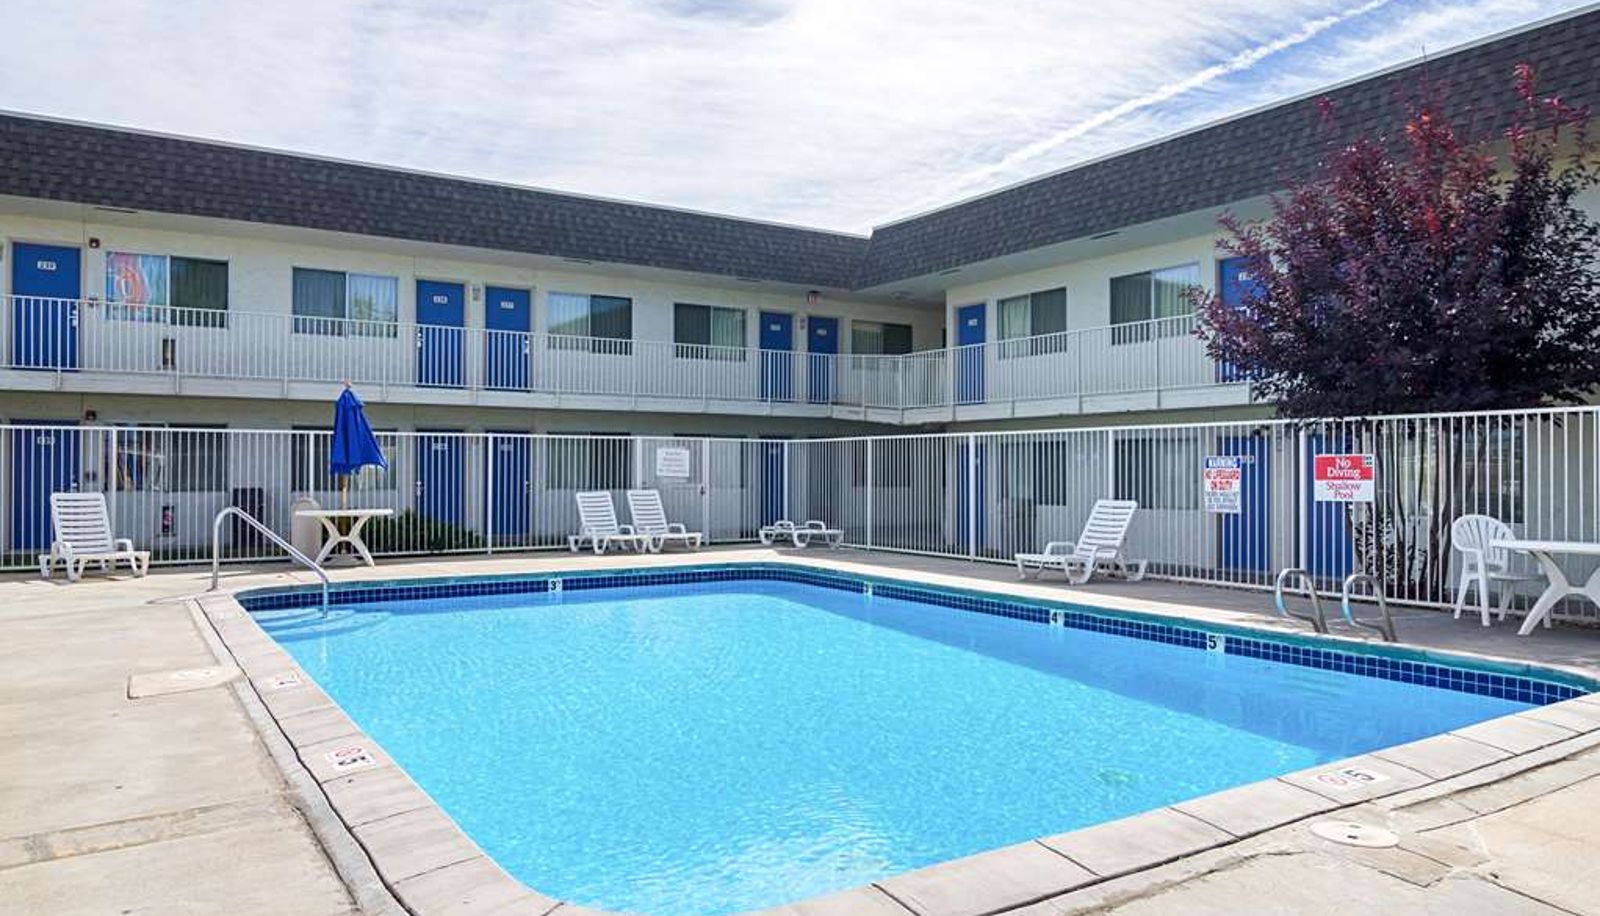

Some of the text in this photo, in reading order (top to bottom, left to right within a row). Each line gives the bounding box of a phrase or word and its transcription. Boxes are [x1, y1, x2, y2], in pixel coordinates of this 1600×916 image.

[1208, 457, 1238, 468] WARNING
[1335, 457, 1351, 468] No
[1327, 466, 1361, 480] Diving
[1327, 482, 1361, 491] Shallow
[1334, 490, 1353, 500] Pool
